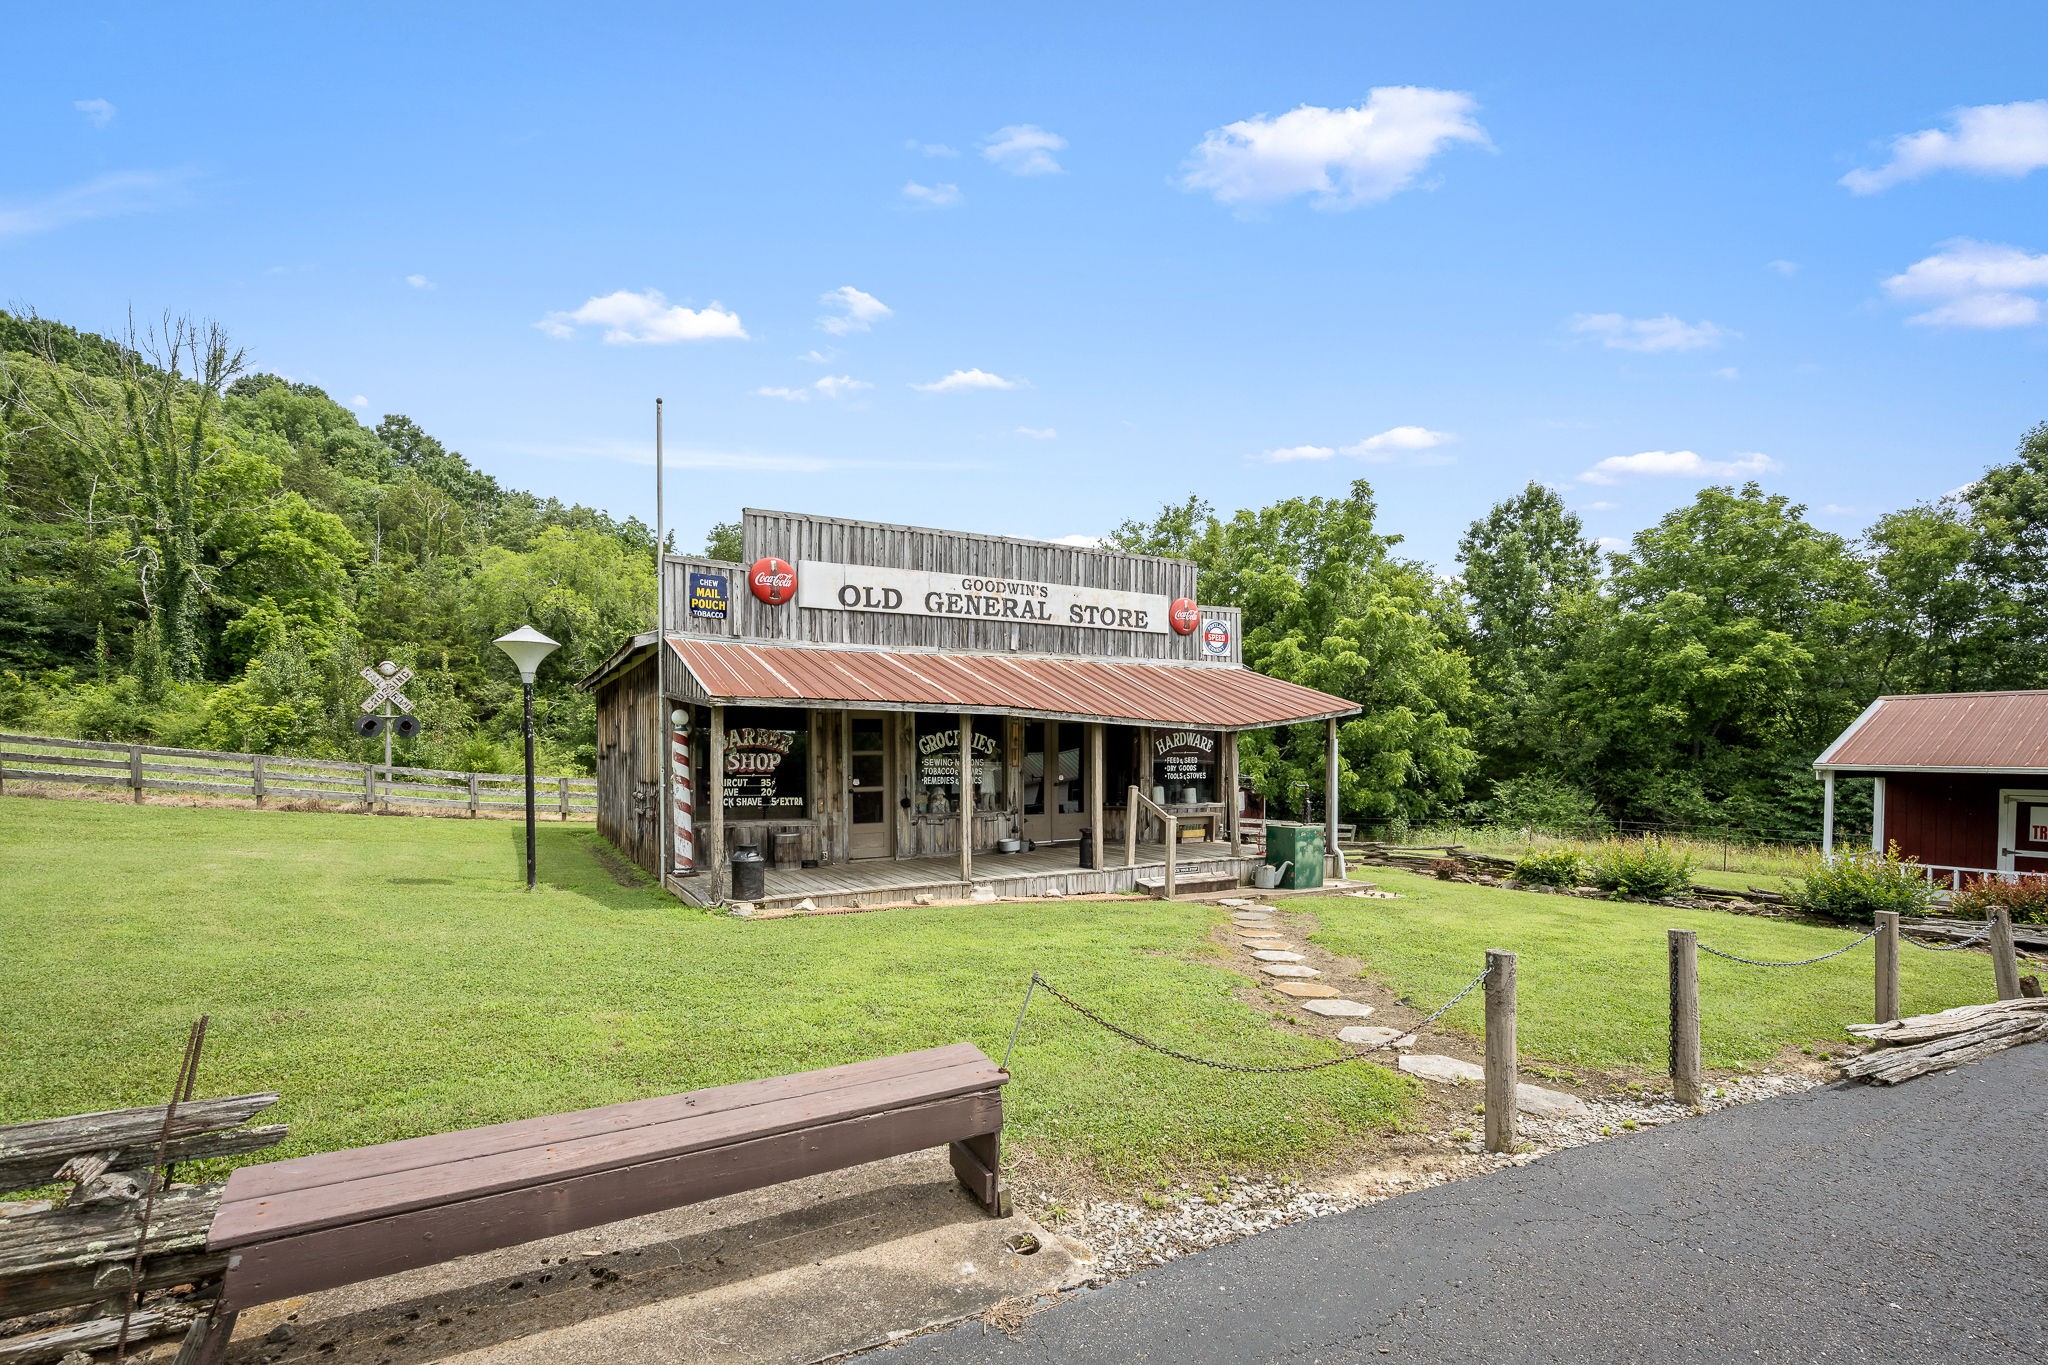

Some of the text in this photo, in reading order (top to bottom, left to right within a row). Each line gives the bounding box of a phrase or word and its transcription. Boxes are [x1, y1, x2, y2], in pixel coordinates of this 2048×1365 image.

[700, 579, 719, 588] CHEW
[756, 572, 794, 588] Coca-Cola
[962, 578, 1048, 598] GOODWIN'S
[697, 588, 721, 599] MAIL
[692, 599, 726, 611] POUCH
[838, 584, 1149, 629] OLD GENERAL STORE
[693, 610, 724, 619] TOBACCO
[1207, 633, 1226, 642] SPEED
[1155, 732, 1214, 755] HARDWARE
[727, 753, 782, 771] SHOP
[924, 759, 953, 767] SEWING
[924, 768, 955, 776] TOBACCO
[723, 778, 748, 787] IRCUT
[924, 777, 955, 785] REMEDIES
[723, 788, 739, 797] AVE
[723, 797, 735, 808] CK
[736, 797, 762, 806] SHAVE
[780, 796, 804, 806] EXTRA
